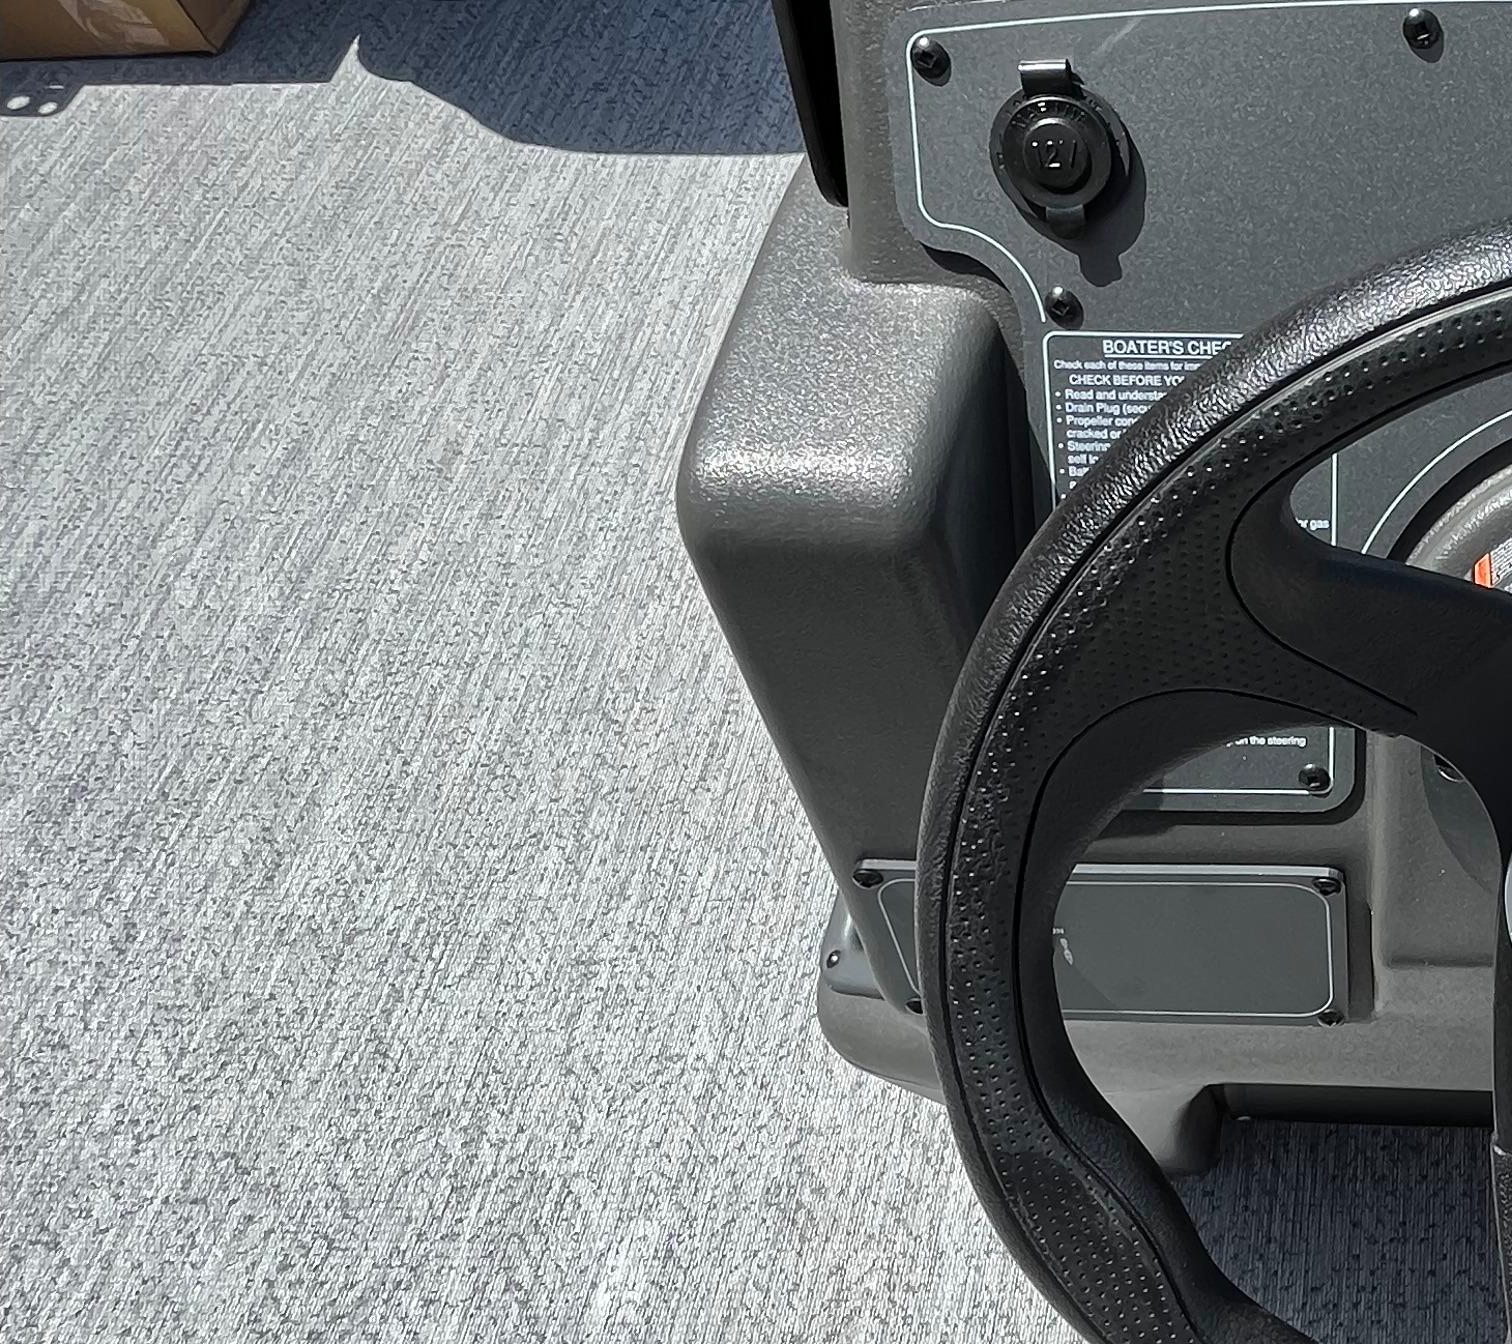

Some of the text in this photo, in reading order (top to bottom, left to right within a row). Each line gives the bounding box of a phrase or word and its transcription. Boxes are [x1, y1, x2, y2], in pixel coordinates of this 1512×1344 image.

[1102, 339, 1185, 355] BOATER'S
[1053, 360, 1082, 370] Check
[1107, 360, 1117, 370] of
[1069, 375, 1185, 386] CHECK BEFORE YO
[1065, 389, 1094, 400] Read
[1095, 389, 1116, 400] and
[1065, 403, 1094, 413] Drain
[1096, 403, 1120, 415] Plug
[1066, 416, 1113, 427] Propeller
